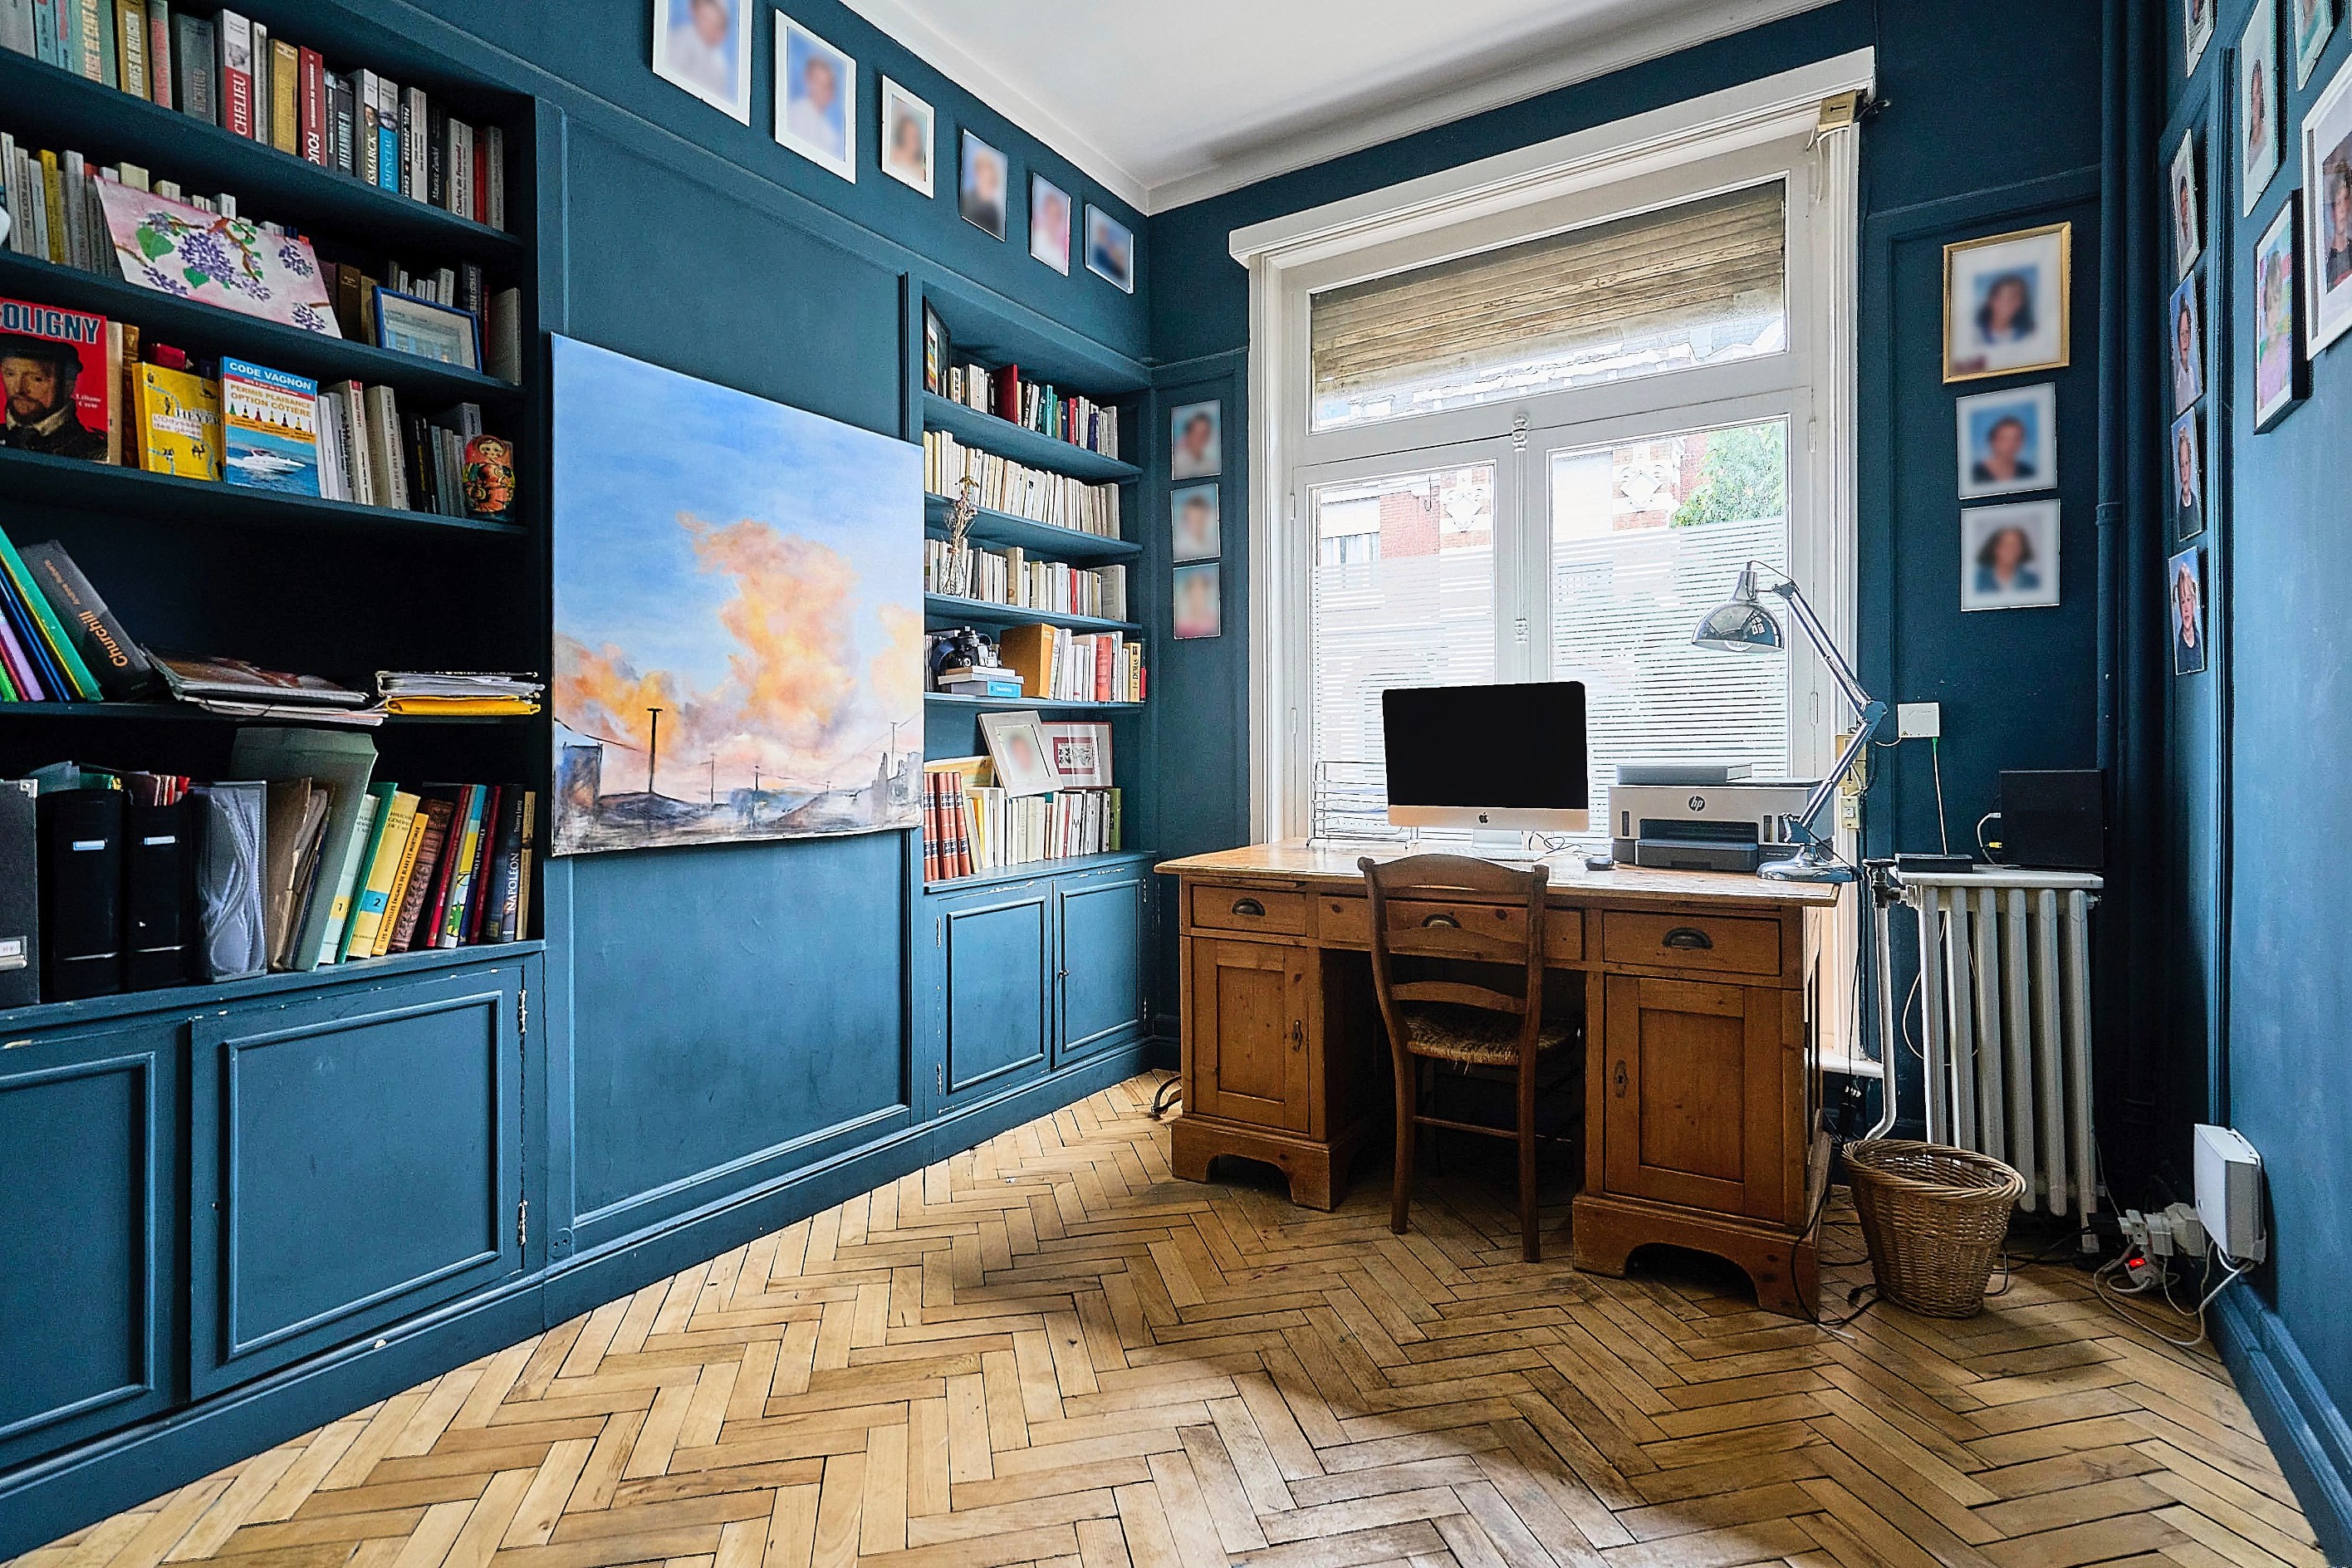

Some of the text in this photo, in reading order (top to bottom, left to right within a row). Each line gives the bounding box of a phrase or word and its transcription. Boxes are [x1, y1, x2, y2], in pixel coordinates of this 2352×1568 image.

[233, 73, 247, 136] CHELIEU
[307, 131, 321, 165] FOUC
[338, 120, 351, 170] ALEXANDRE
[367, 135, 377, 187] ISMARCK
[384, 135, 393, 192] EMENCEAU
[0, 302, 100, 344] OLIGNY
[229, 362, 261, 378] CODE
[263, 370, 311, 390] VAGNON
[230, 384, 311, 408] PERMIS PLAISANCE
[231, 393, 268, 407] OPTION
[79, 610, 129, 668] Churchill
[1689, 796, 1704, 812] hp
[374, 898, 381, 908] 2
[506, 852, 520, 913] NAPOLÉON
